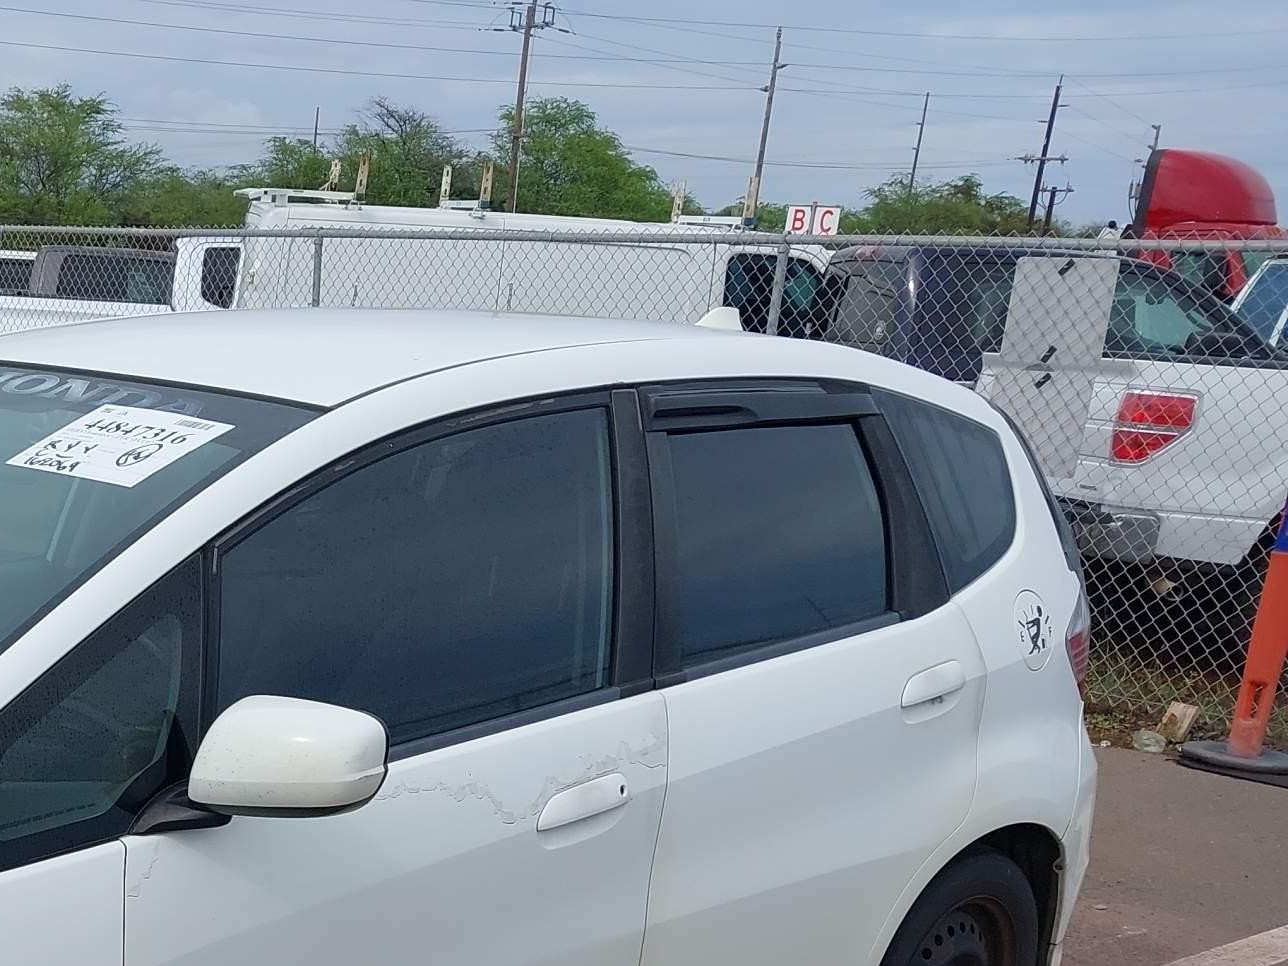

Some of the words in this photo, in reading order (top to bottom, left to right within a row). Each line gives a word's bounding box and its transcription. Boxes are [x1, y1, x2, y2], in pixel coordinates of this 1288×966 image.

[792, 209, 805, 231] B
[820, 210, 834, 232] C
[85, 418, 196, 444] 44847316
